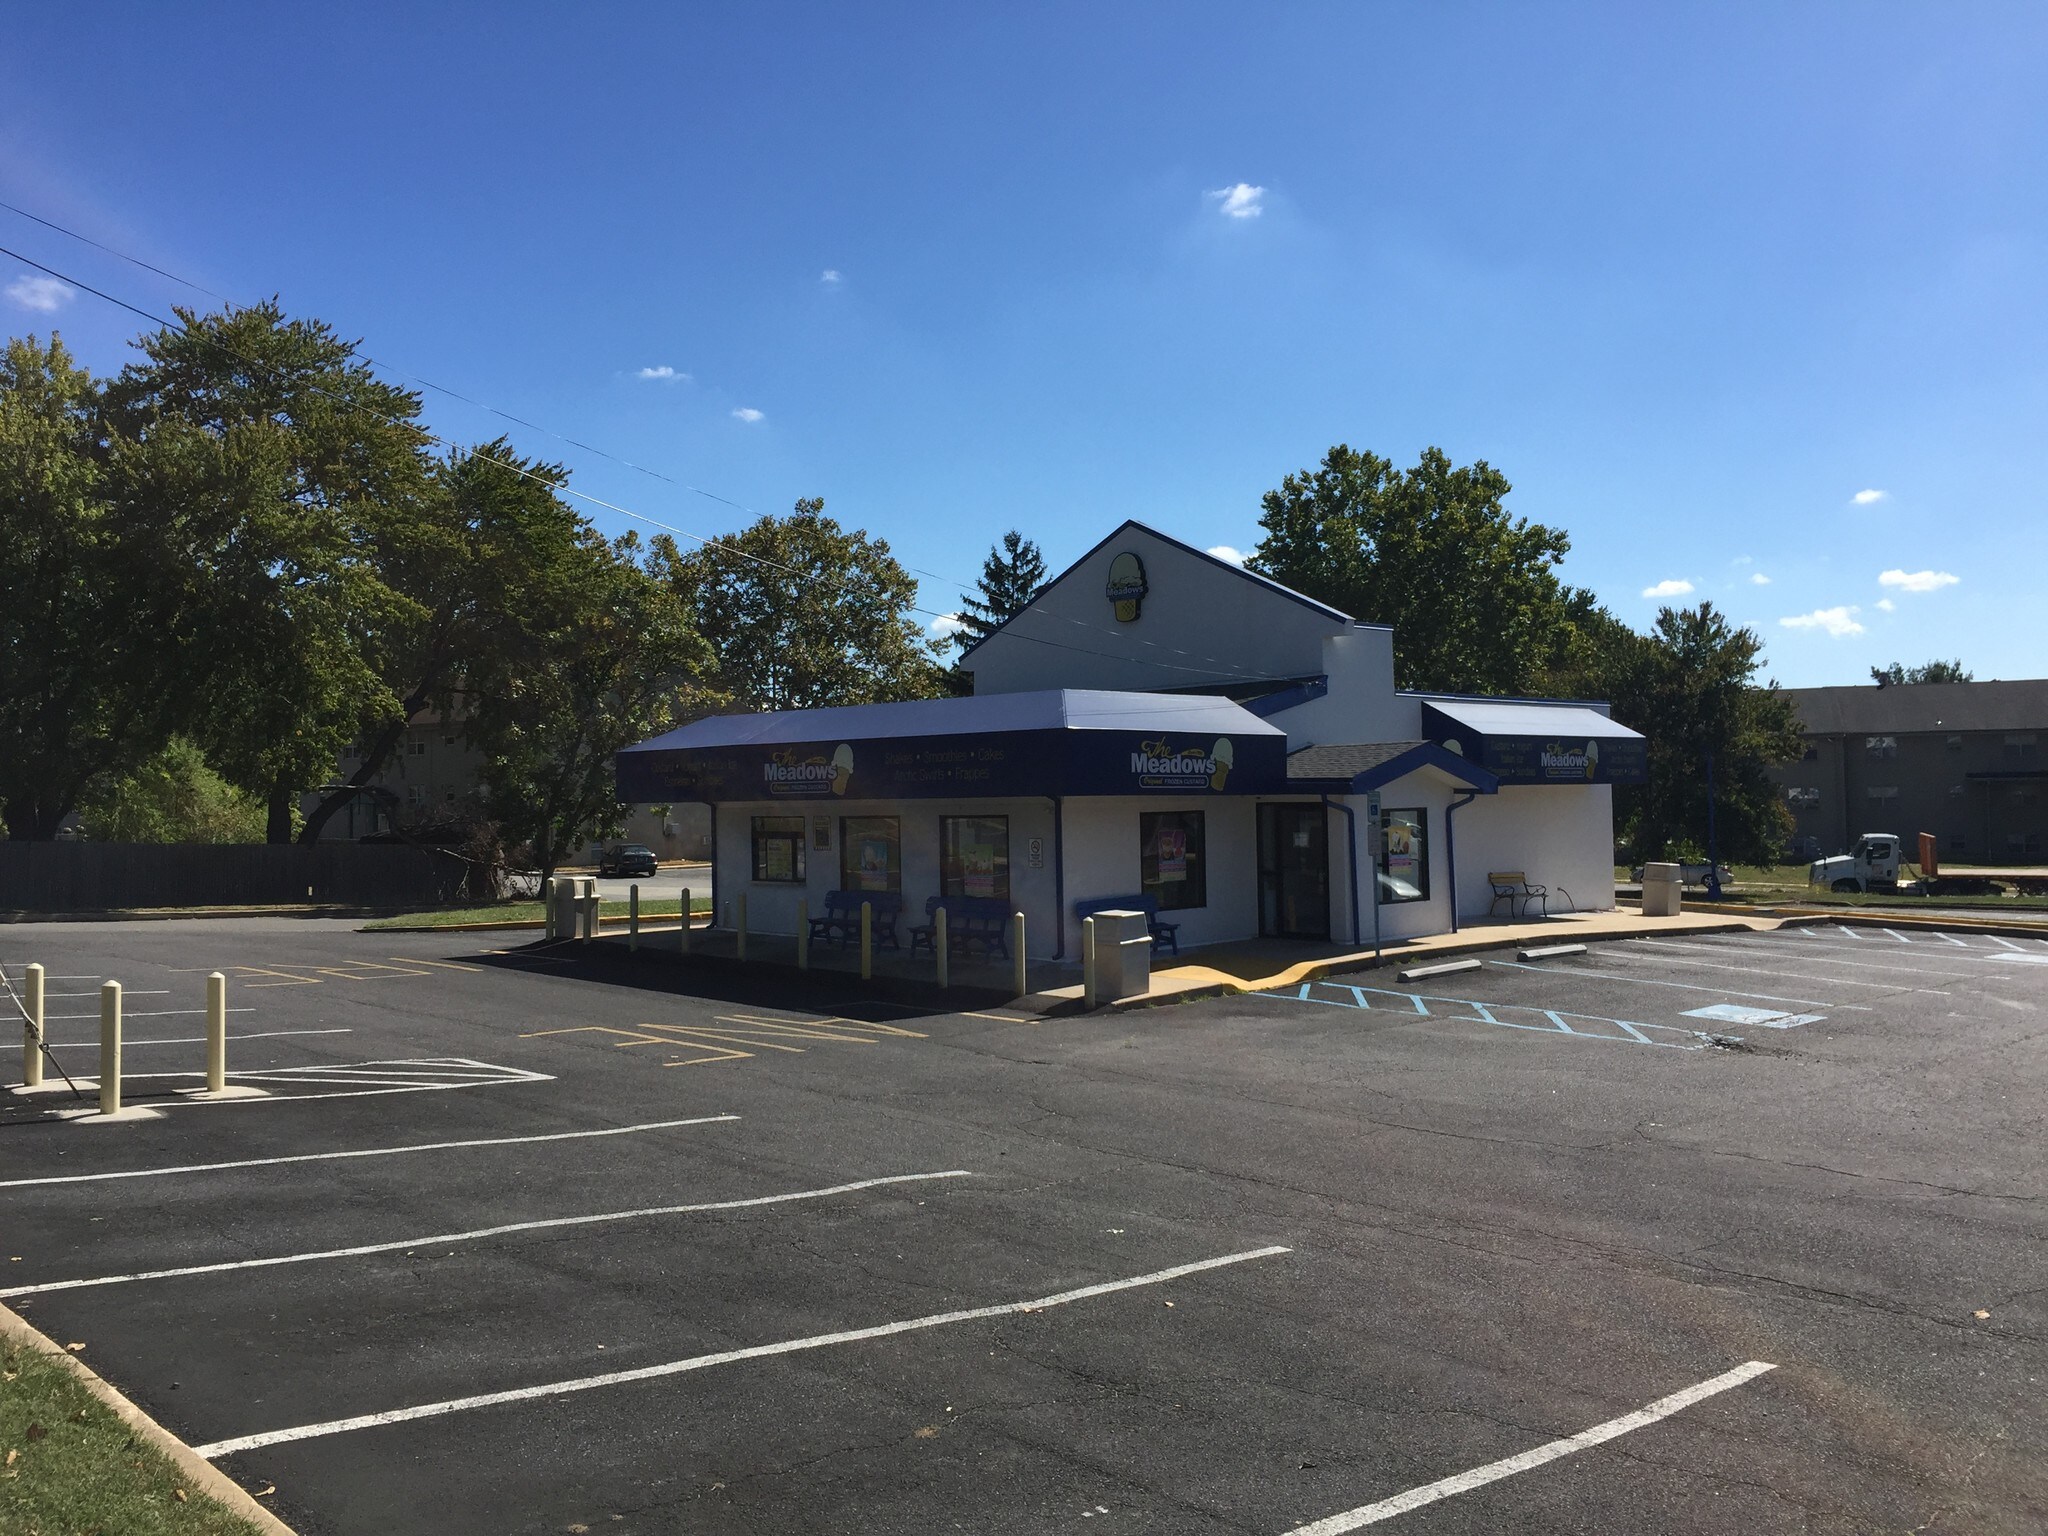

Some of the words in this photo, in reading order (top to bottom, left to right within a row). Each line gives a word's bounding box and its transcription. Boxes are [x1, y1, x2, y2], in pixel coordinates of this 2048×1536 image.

[1107, 586, 1143, 597] Meadows
[1141, 736, 1175, 758] The
[771, 747, 802, 767] The
[922, 749, 967, 764] Smoothies
[977, 748, 1005, 761] Cakes
[1131, 752, 1217, 774] Meadows
[1540, 752, 1589, 767] Meadows
[764, 762, 838, 781] Meadows
[955, 767, 990, 782] Frappes
